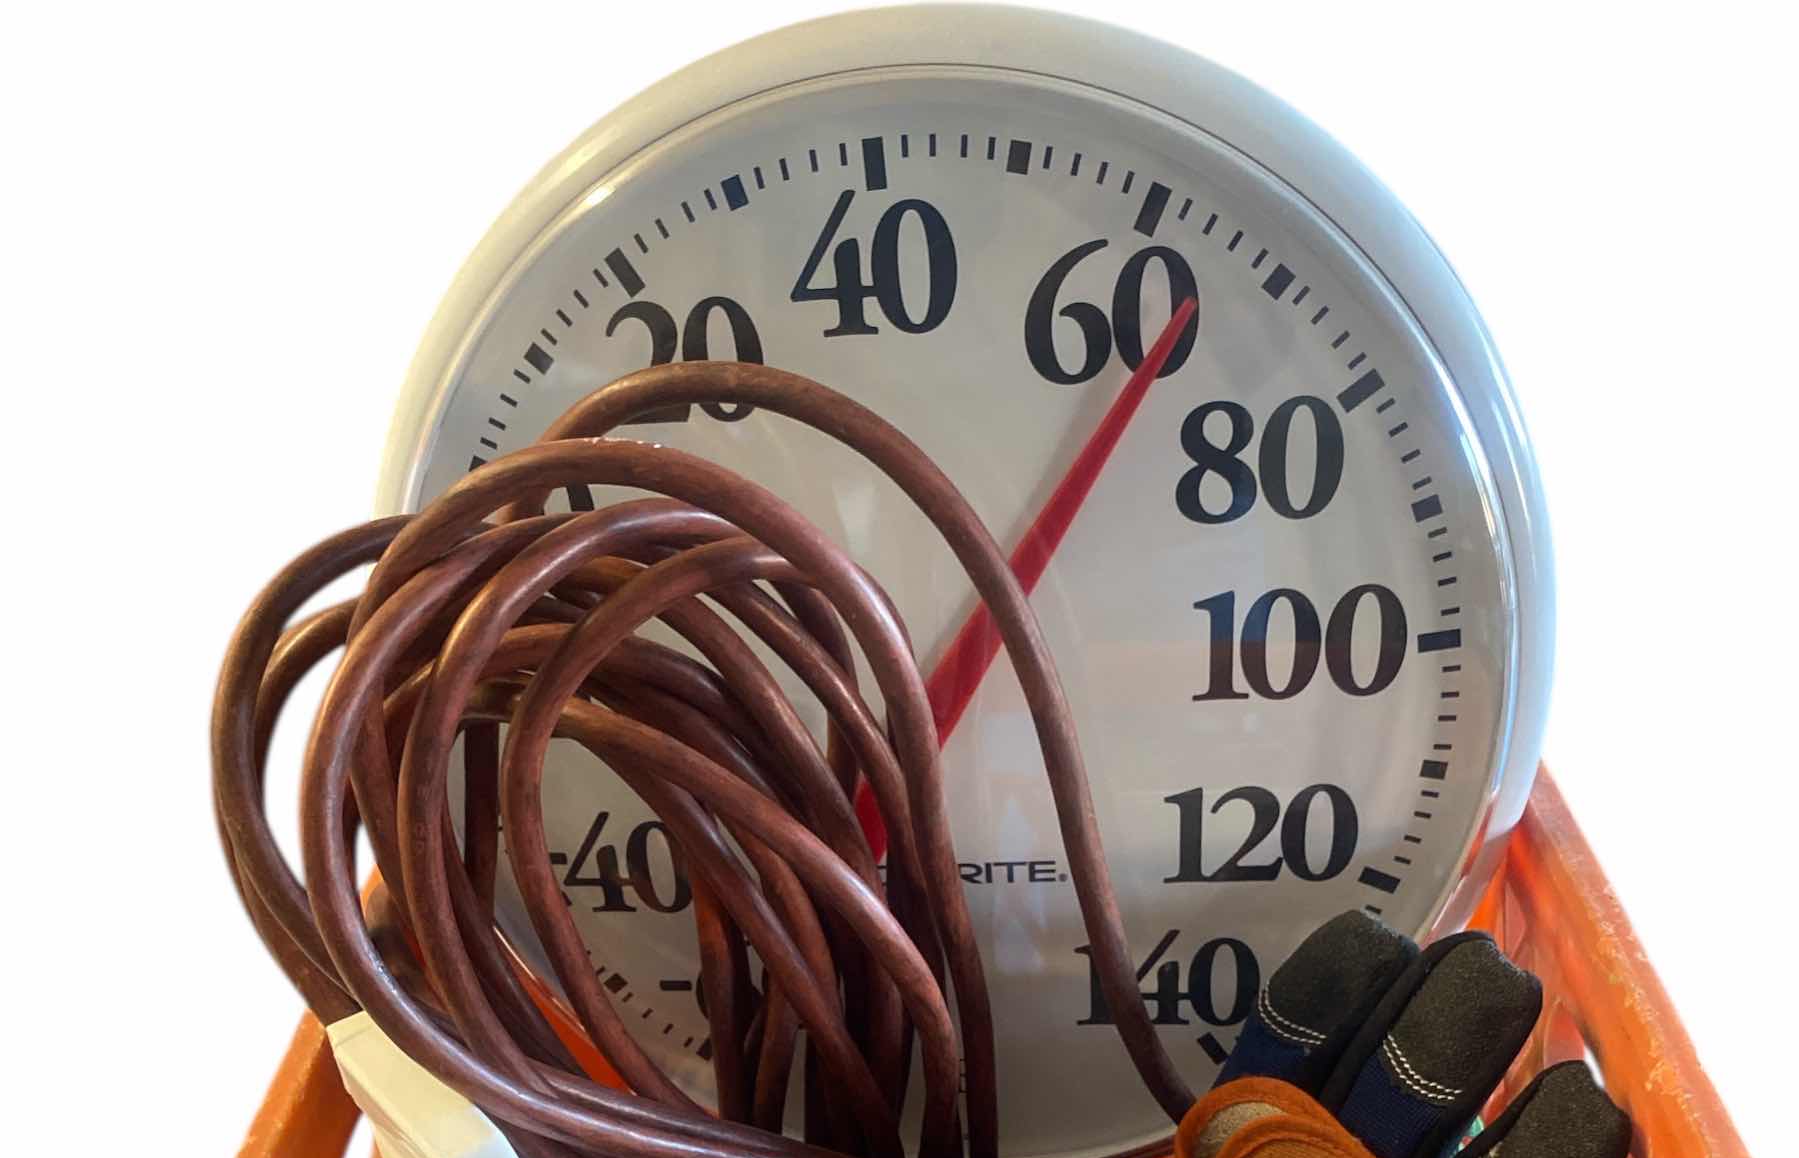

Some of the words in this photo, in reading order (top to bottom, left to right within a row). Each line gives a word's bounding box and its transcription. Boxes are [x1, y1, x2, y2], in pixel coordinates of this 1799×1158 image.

[790, 189, 958, 337] 40
[1024, 238, 1199, 385] 60
[605, 296, 764, 425] 20
[1175, 395, 1344, 524] 80
[1192, 584, 1408, 701] 100
[1163, 783, 1359, 883] 120
[1074, 930, 1260, 1026] 140
